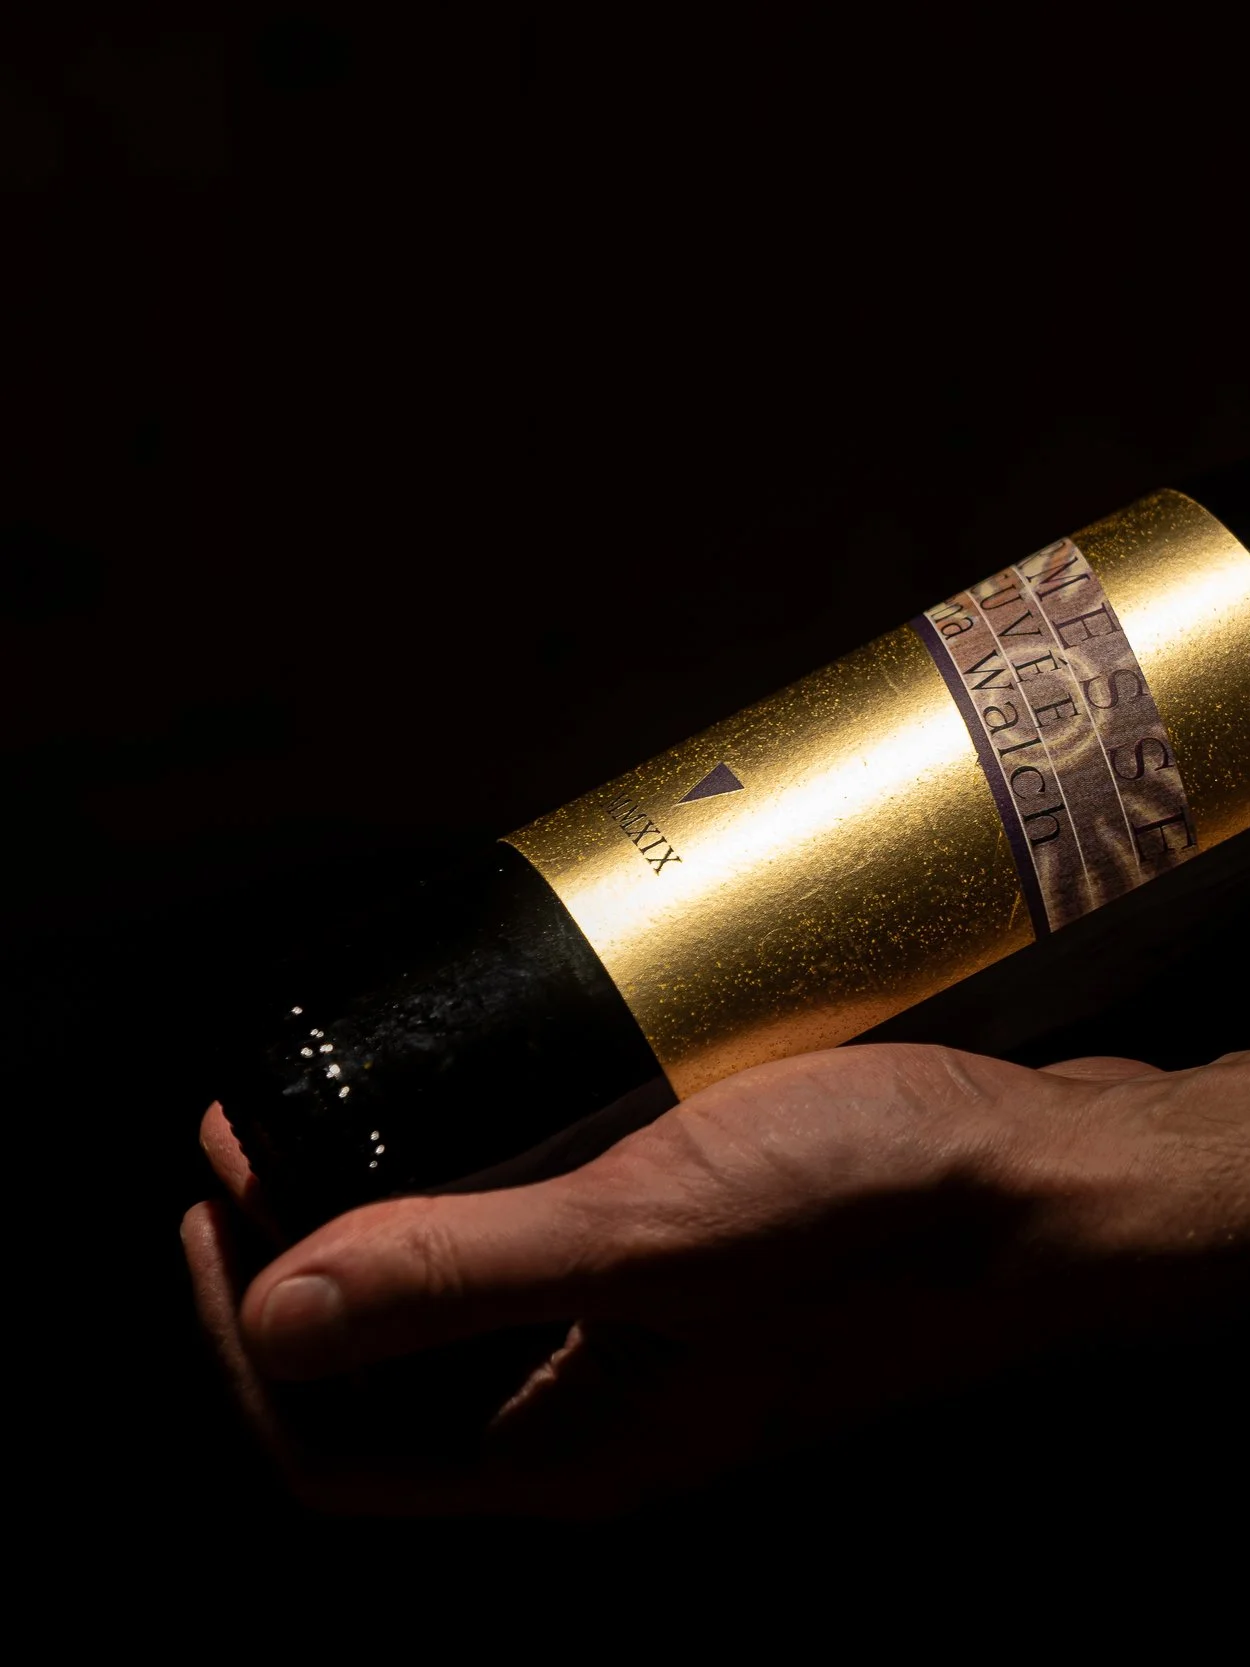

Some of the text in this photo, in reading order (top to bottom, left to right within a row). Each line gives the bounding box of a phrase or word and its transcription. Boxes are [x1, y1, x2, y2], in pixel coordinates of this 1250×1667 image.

[927, 601, 1066, 846] na Walch
[969, 573, 1080, 728] UVÉE
